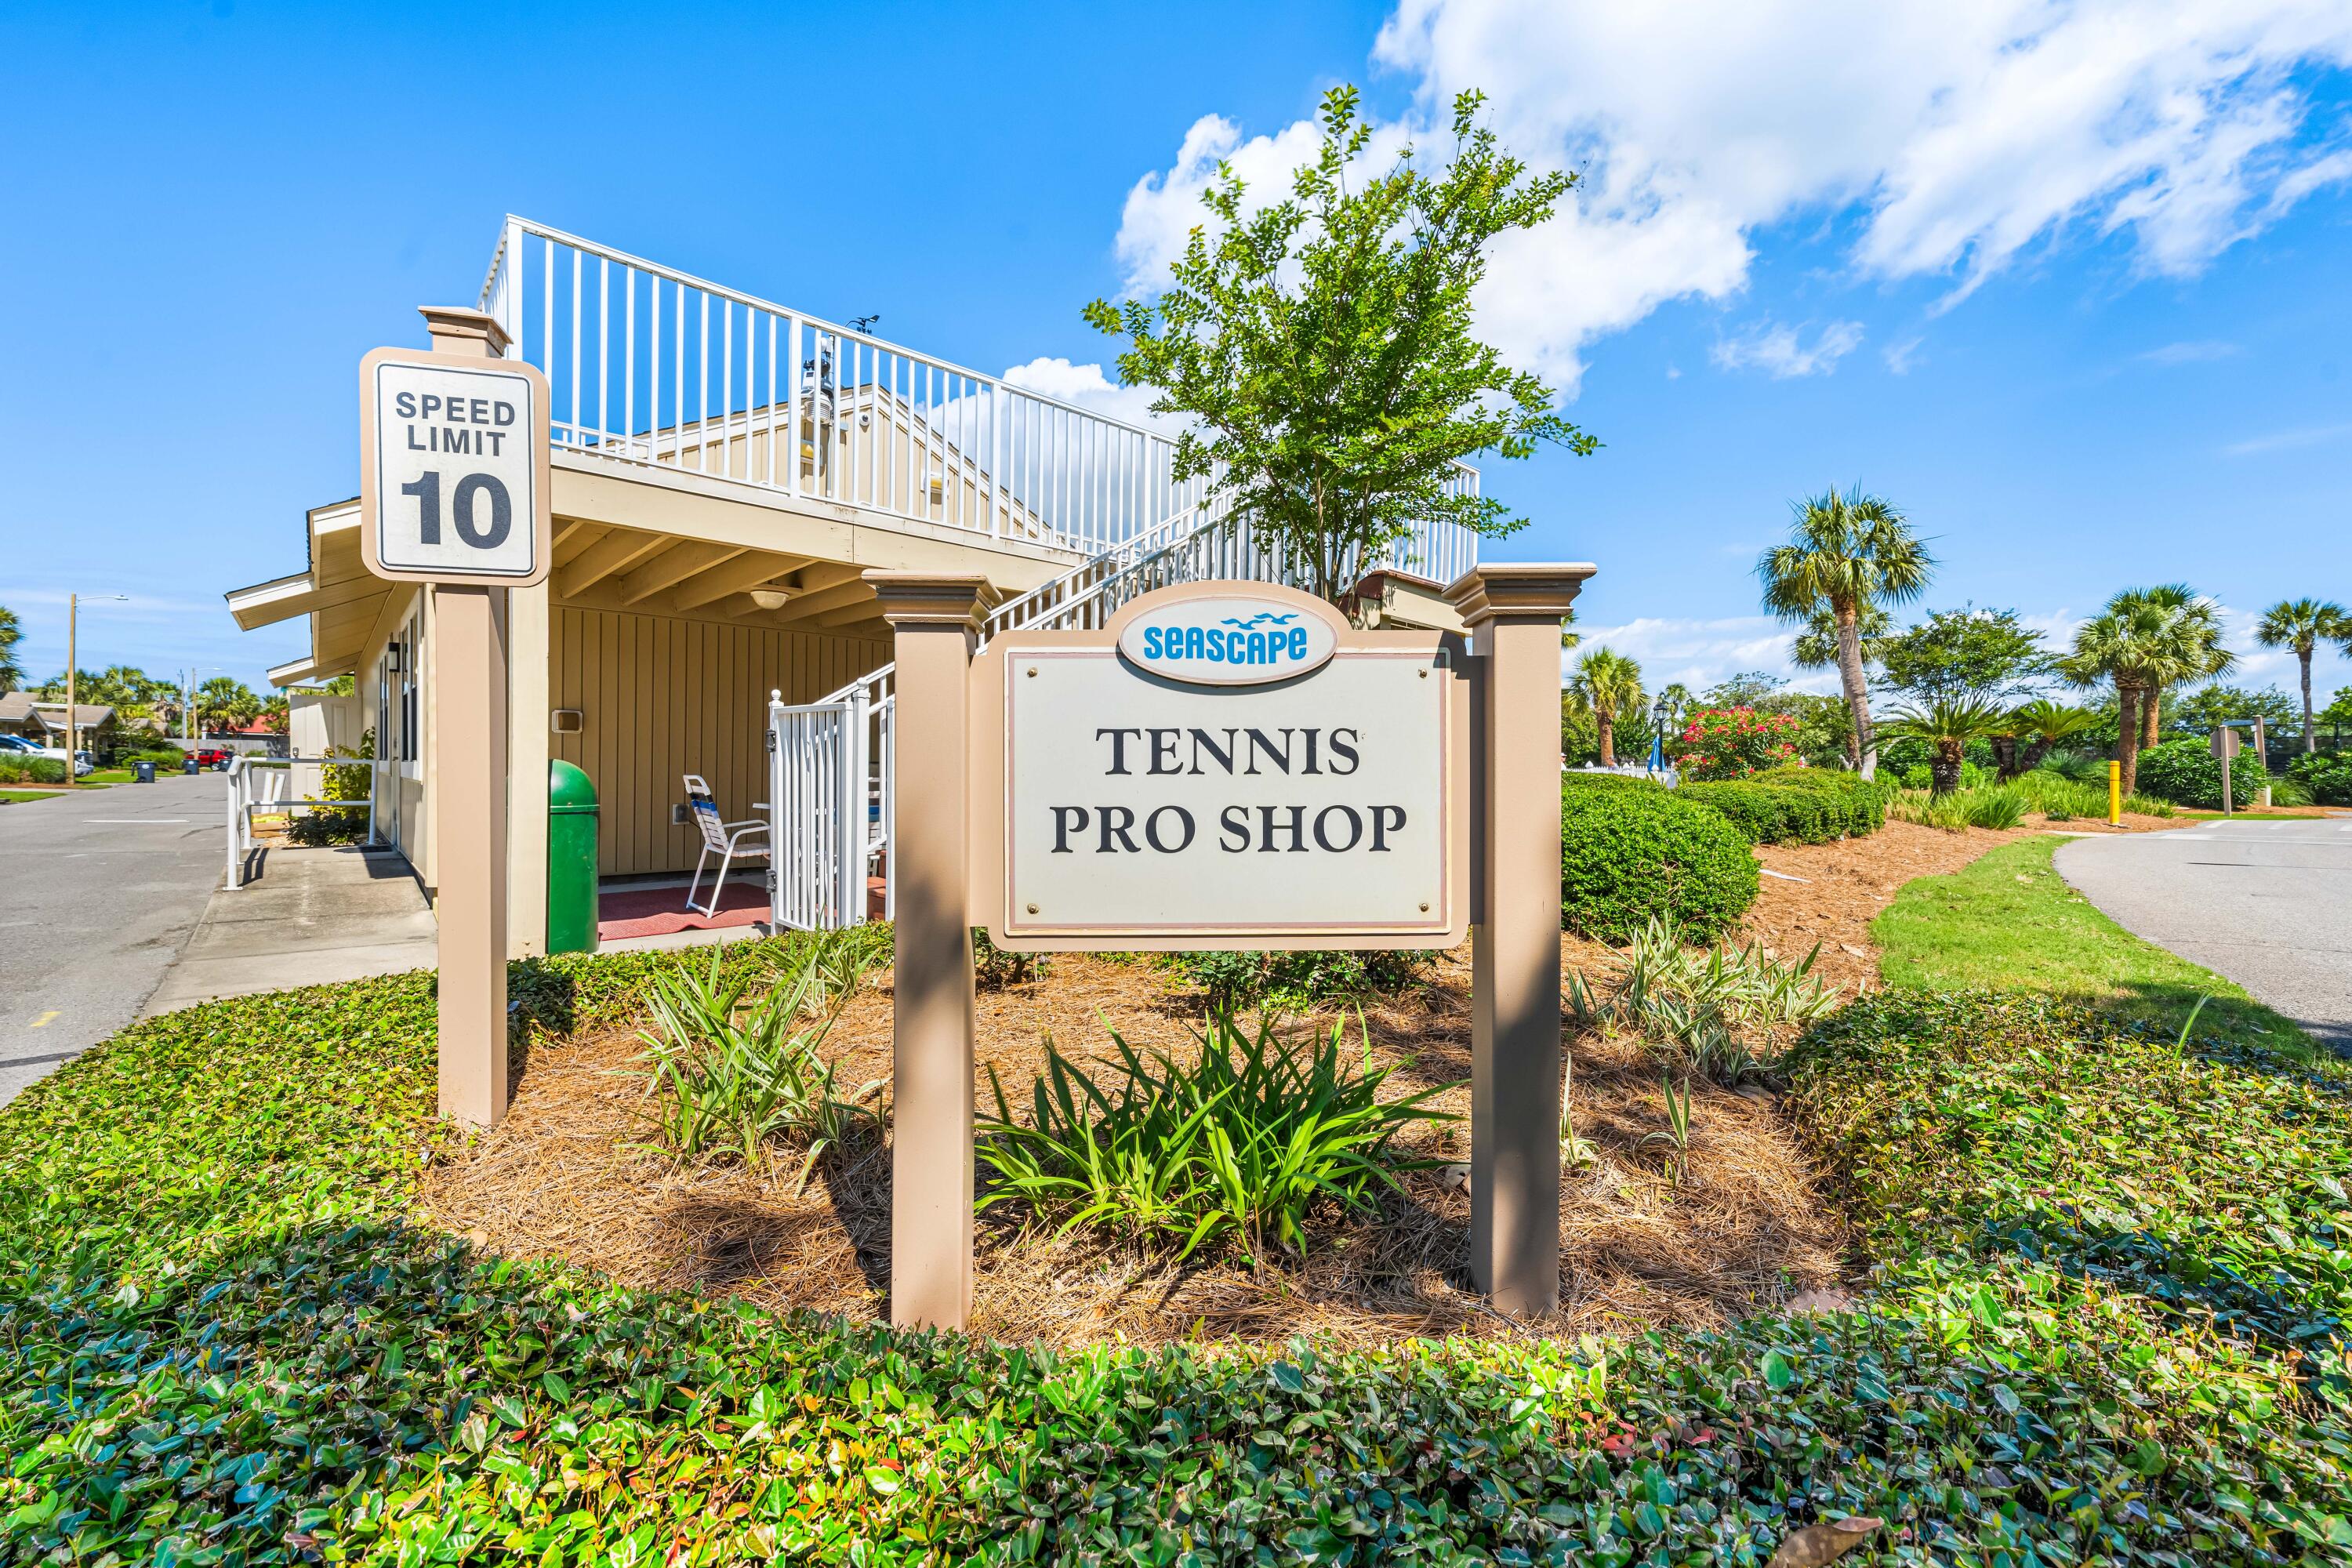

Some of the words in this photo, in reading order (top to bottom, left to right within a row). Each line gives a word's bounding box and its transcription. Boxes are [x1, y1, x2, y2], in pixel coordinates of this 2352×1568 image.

[396, 391, 515, 426] SPEED
[408, 424, 506, 456] LIMIT
[401, 470, 512, 550] 10
[1095, 728, 1359, 775] TENNIS
[1050, 805, 1196, 854] PRO
[1219, 805, 1407, 853] SHOP
